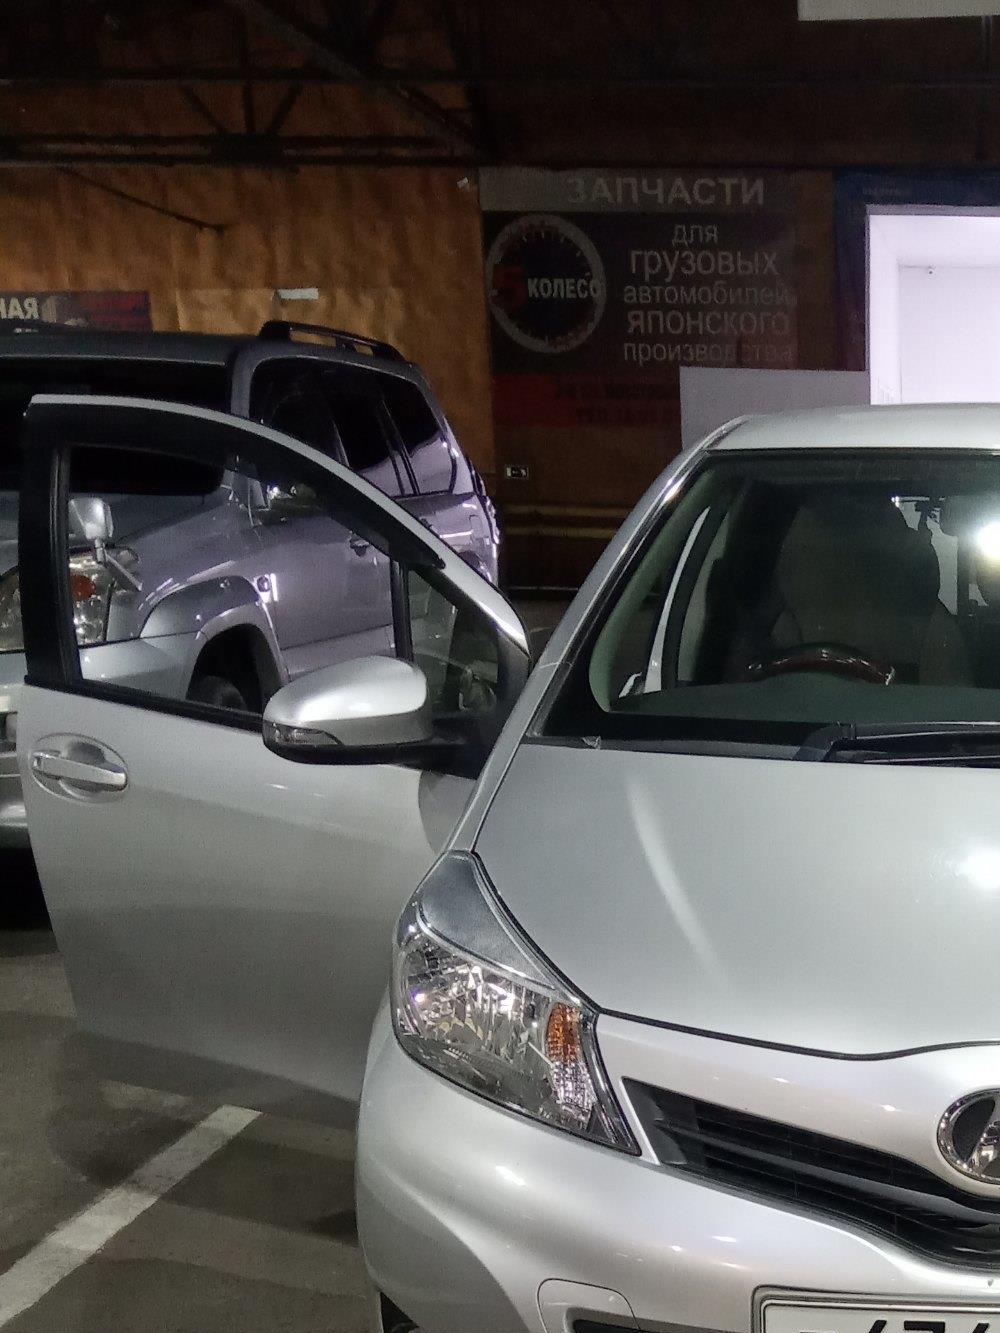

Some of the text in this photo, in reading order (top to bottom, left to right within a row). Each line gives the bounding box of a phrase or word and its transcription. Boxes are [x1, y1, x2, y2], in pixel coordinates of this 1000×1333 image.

[568, 176, 765, 207] ЗАПЧАСТИ
[671, 223, 719, 247] для
[629, 249, 780, 283] грузовых
[527, 277, 604, 299] КОЛЕСО
[623, 342, 794, 366] производства
